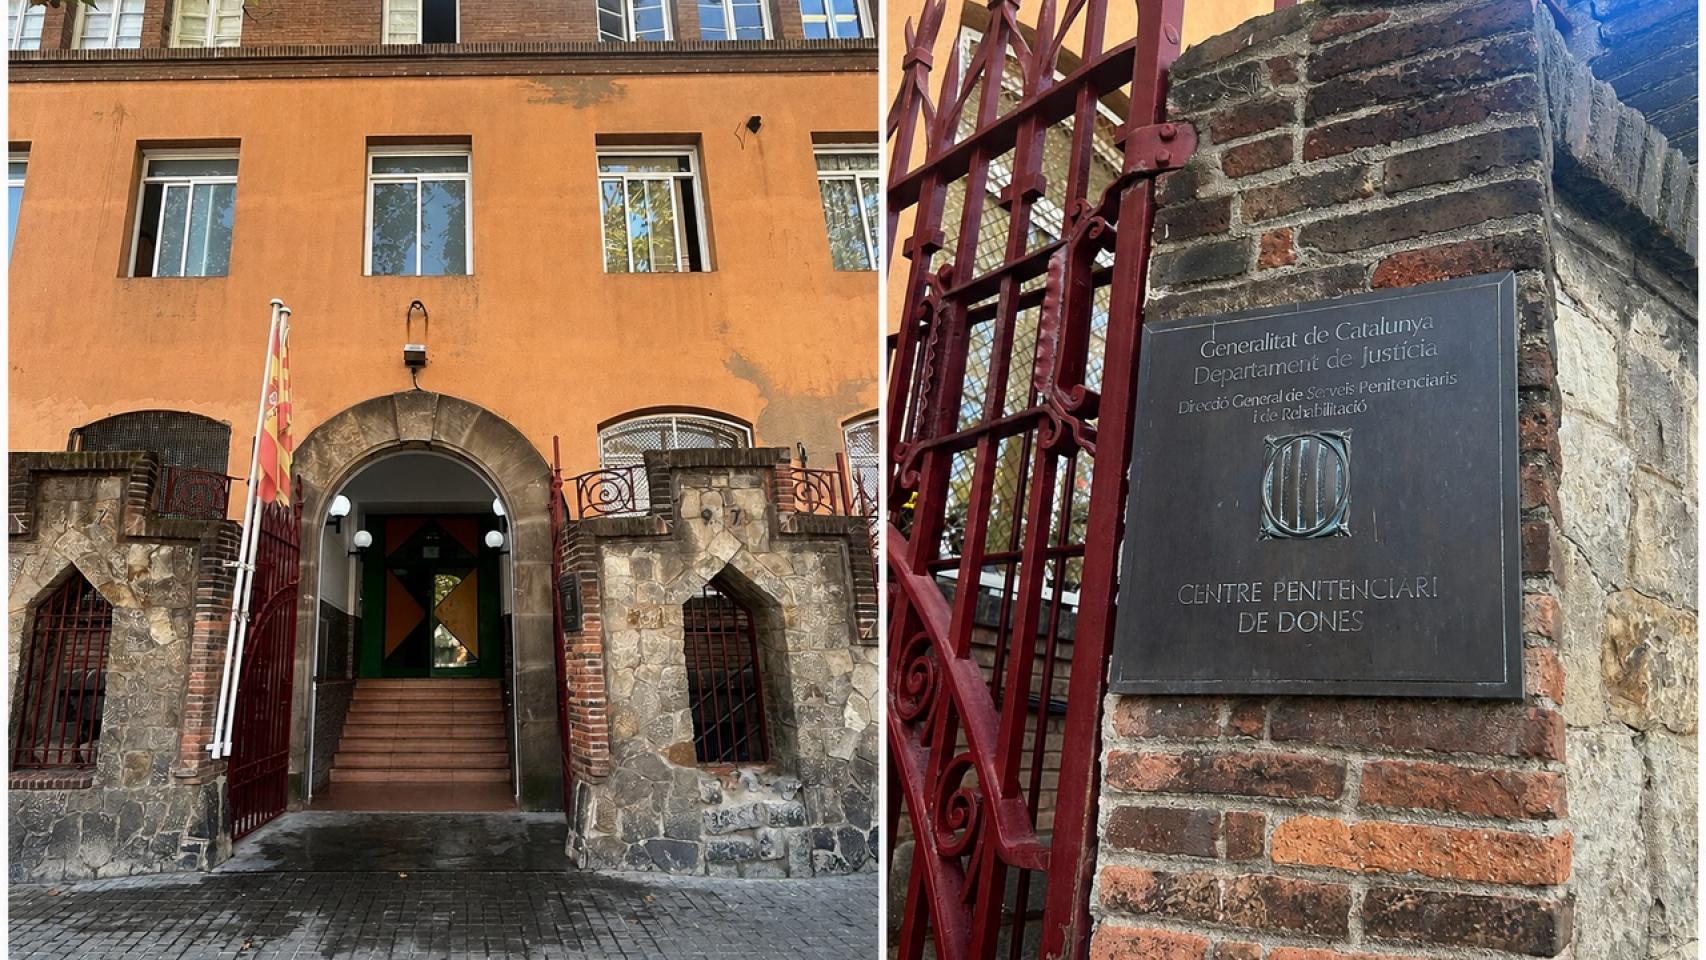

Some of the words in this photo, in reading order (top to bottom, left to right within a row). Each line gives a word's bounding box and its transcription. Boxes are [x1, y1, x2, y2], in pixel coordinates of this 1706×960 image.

[1200, 332, 1297, 358] Generalitat
[1304, 325, 1330, 345] de
[1335, 315, 1434, 341] Catalunya
[1194, 354, 1319, 388] Departament
[1326, 348, 1353, 369] de
[1360, 338, 1439, 369] Justícia
[1232, 389, 1283, 408] General
[1285, 387, 1304, 402] de
[1306, 382, 1355, 401] Serveis
[1359, 371, 1459, 394] Penitenciaris
[1253, 410, 1258, 424] i
[1260, 407, 1278, 423] de
[1281, 399, 1368, 421] Rehabilitació
[1177, 582, 1262, 605] CENTRE
[1273, 576, 1438, 602] PENITENCIARI
[1238, 611, 1269, 633] DE
[1278, 610, 1364, 633] DONES
